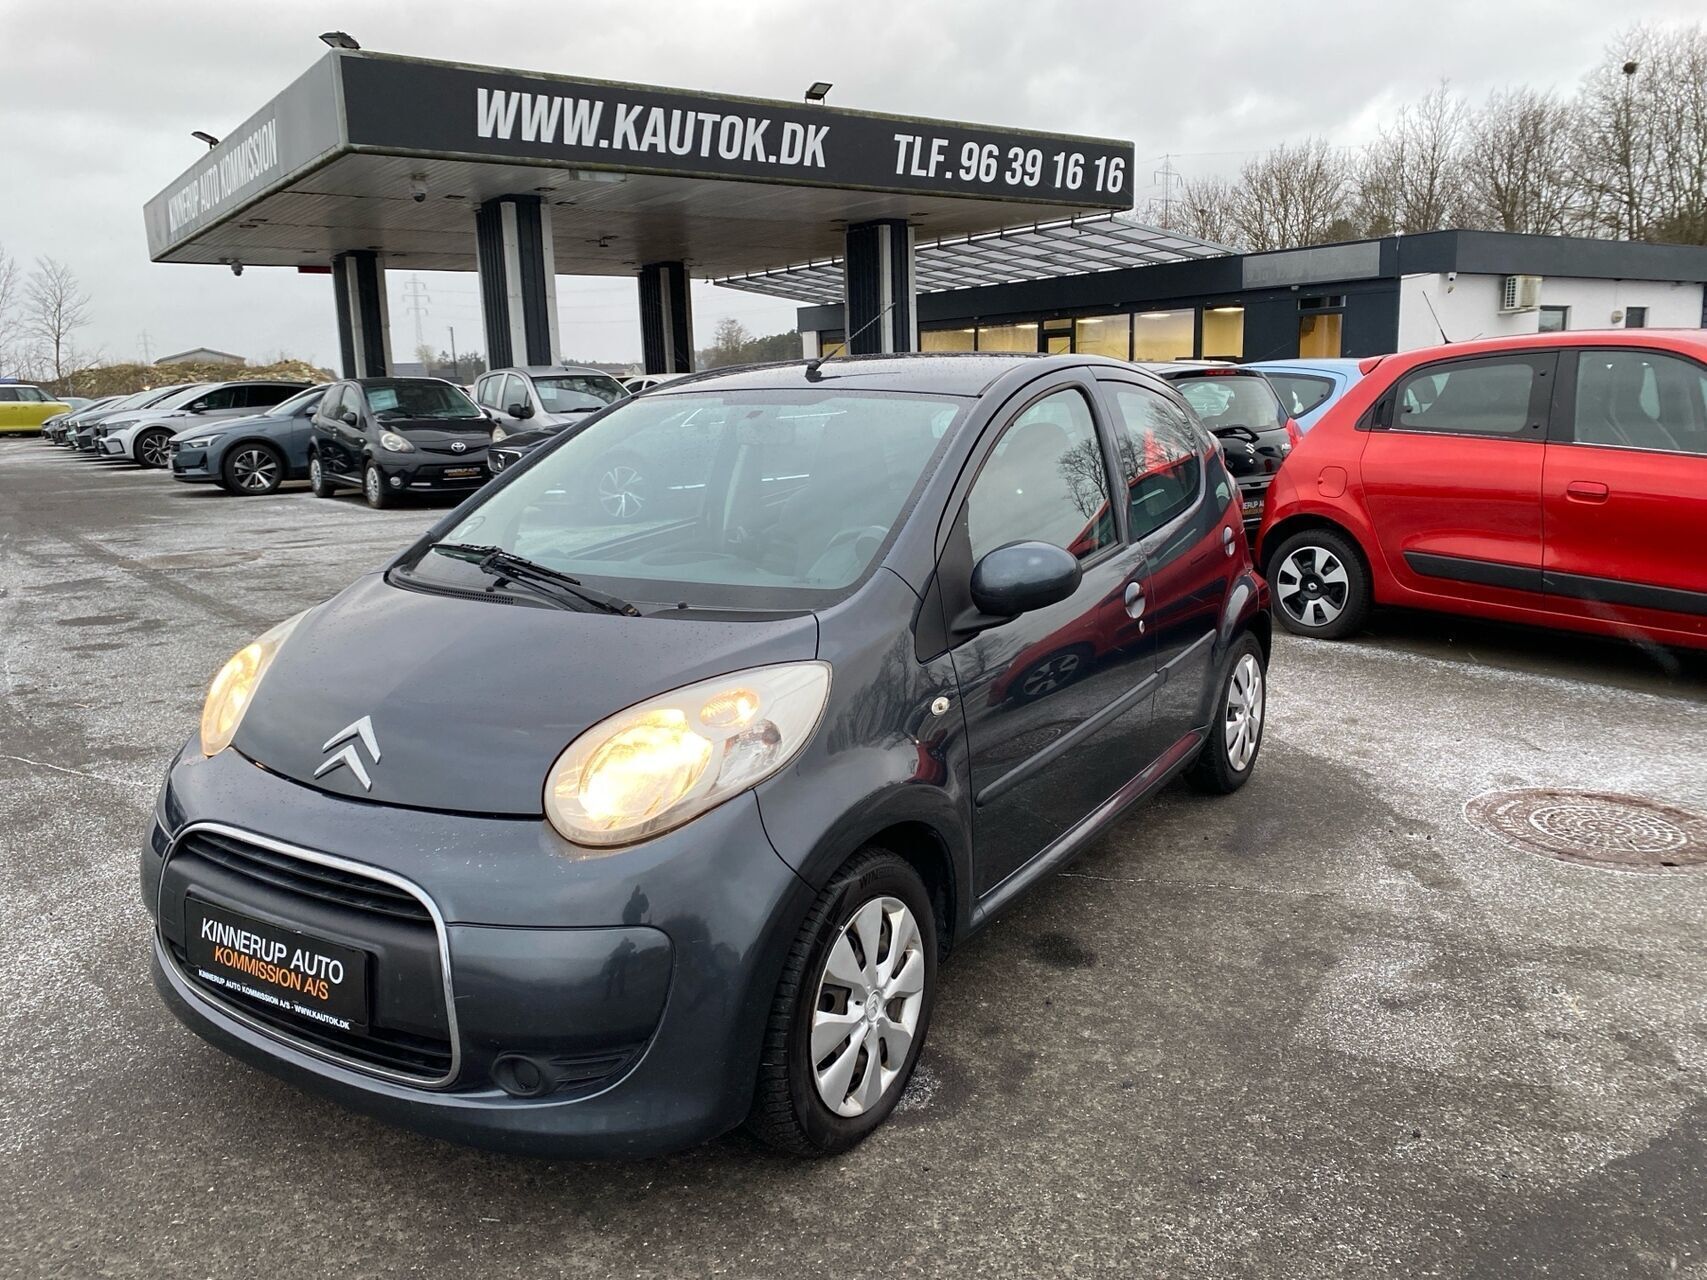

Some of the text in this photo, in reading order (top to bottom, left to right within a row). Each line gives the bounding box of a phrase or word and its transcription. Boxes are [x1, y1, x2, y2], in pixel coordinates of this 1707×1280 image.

[477, 88, 830, 168] WWW.KAUTOK.DK
[200, 164, 220, 213] AUTO
[220, 118, 278, 200] KOMMISSION
[894, 134, 1126, 193] TLF. 96 39 16 16
[201, 918, 344, 984] KINNERUP AUTO
[214, 945, 329, 1000] KOMMISSION A/S
[199, 969, 225, 984] KINNERUP
[225, 980, 241, 992] AUTO
[241, 983, 279, 1005] KOMMISSION
[279, 999, 290, 1010] A/S
[294, 1004, 350, 1030] WWW.KAUTOK.DK
